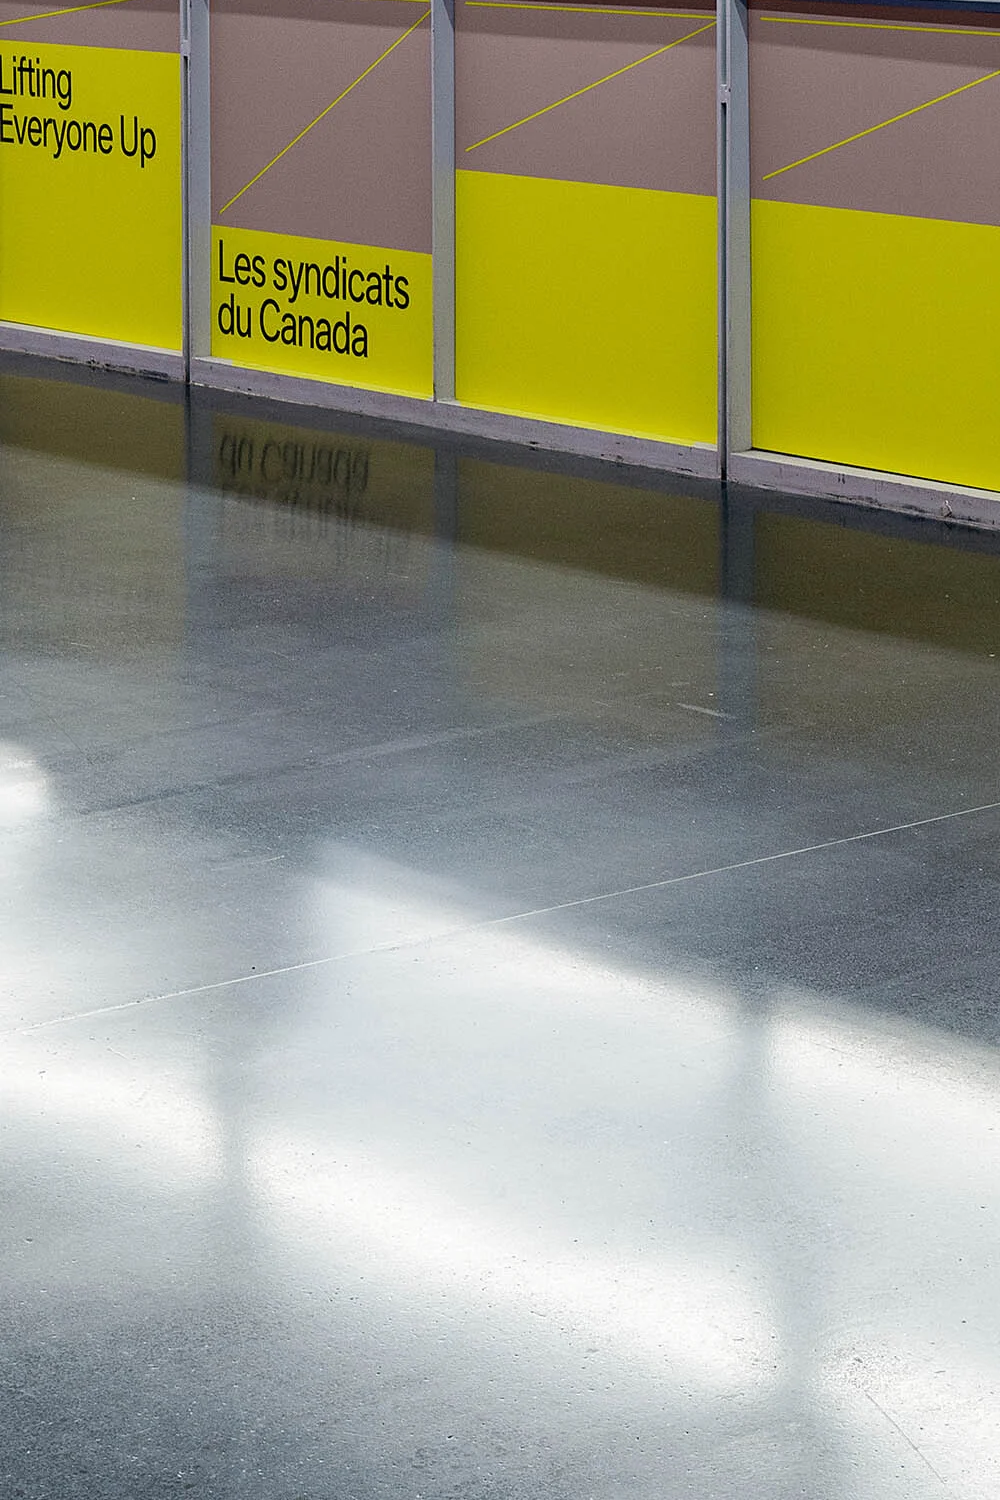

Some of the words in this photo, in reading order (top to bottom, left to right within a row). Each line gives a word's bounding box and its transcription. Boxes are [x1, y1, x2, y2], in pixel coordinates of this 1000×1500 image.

[0, 54, 72, 110] Lifting
[0, 103, 113, 159] Everyone
[120, 115, 157, 168] Up
[218, 239, 266, 286] Les
[272, 255, 410, 309] syndicats
[218, 294, 252, 338] du
[259, 298, 369, 357] Canada
